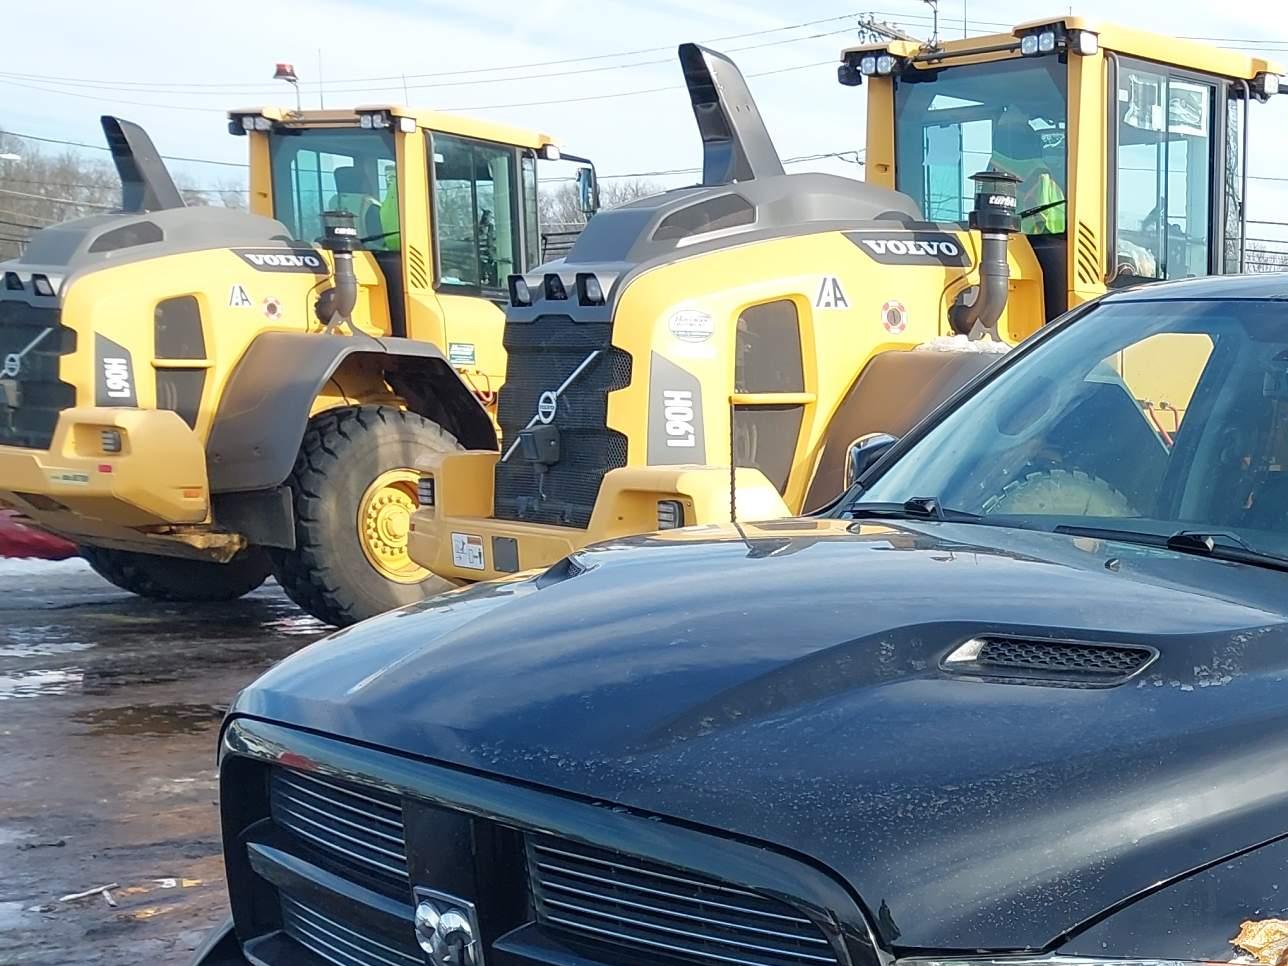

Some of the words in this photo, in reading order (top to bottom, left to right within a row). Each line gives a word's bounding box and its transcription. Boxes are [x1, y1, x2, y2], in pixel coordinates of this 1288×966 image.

[244, 253, 320, 267] VOLVO
[862, 239, 959, 256] VOLVO
[103, 357, 131, 398] L90H
[663, 390, 696, 447] L90H
